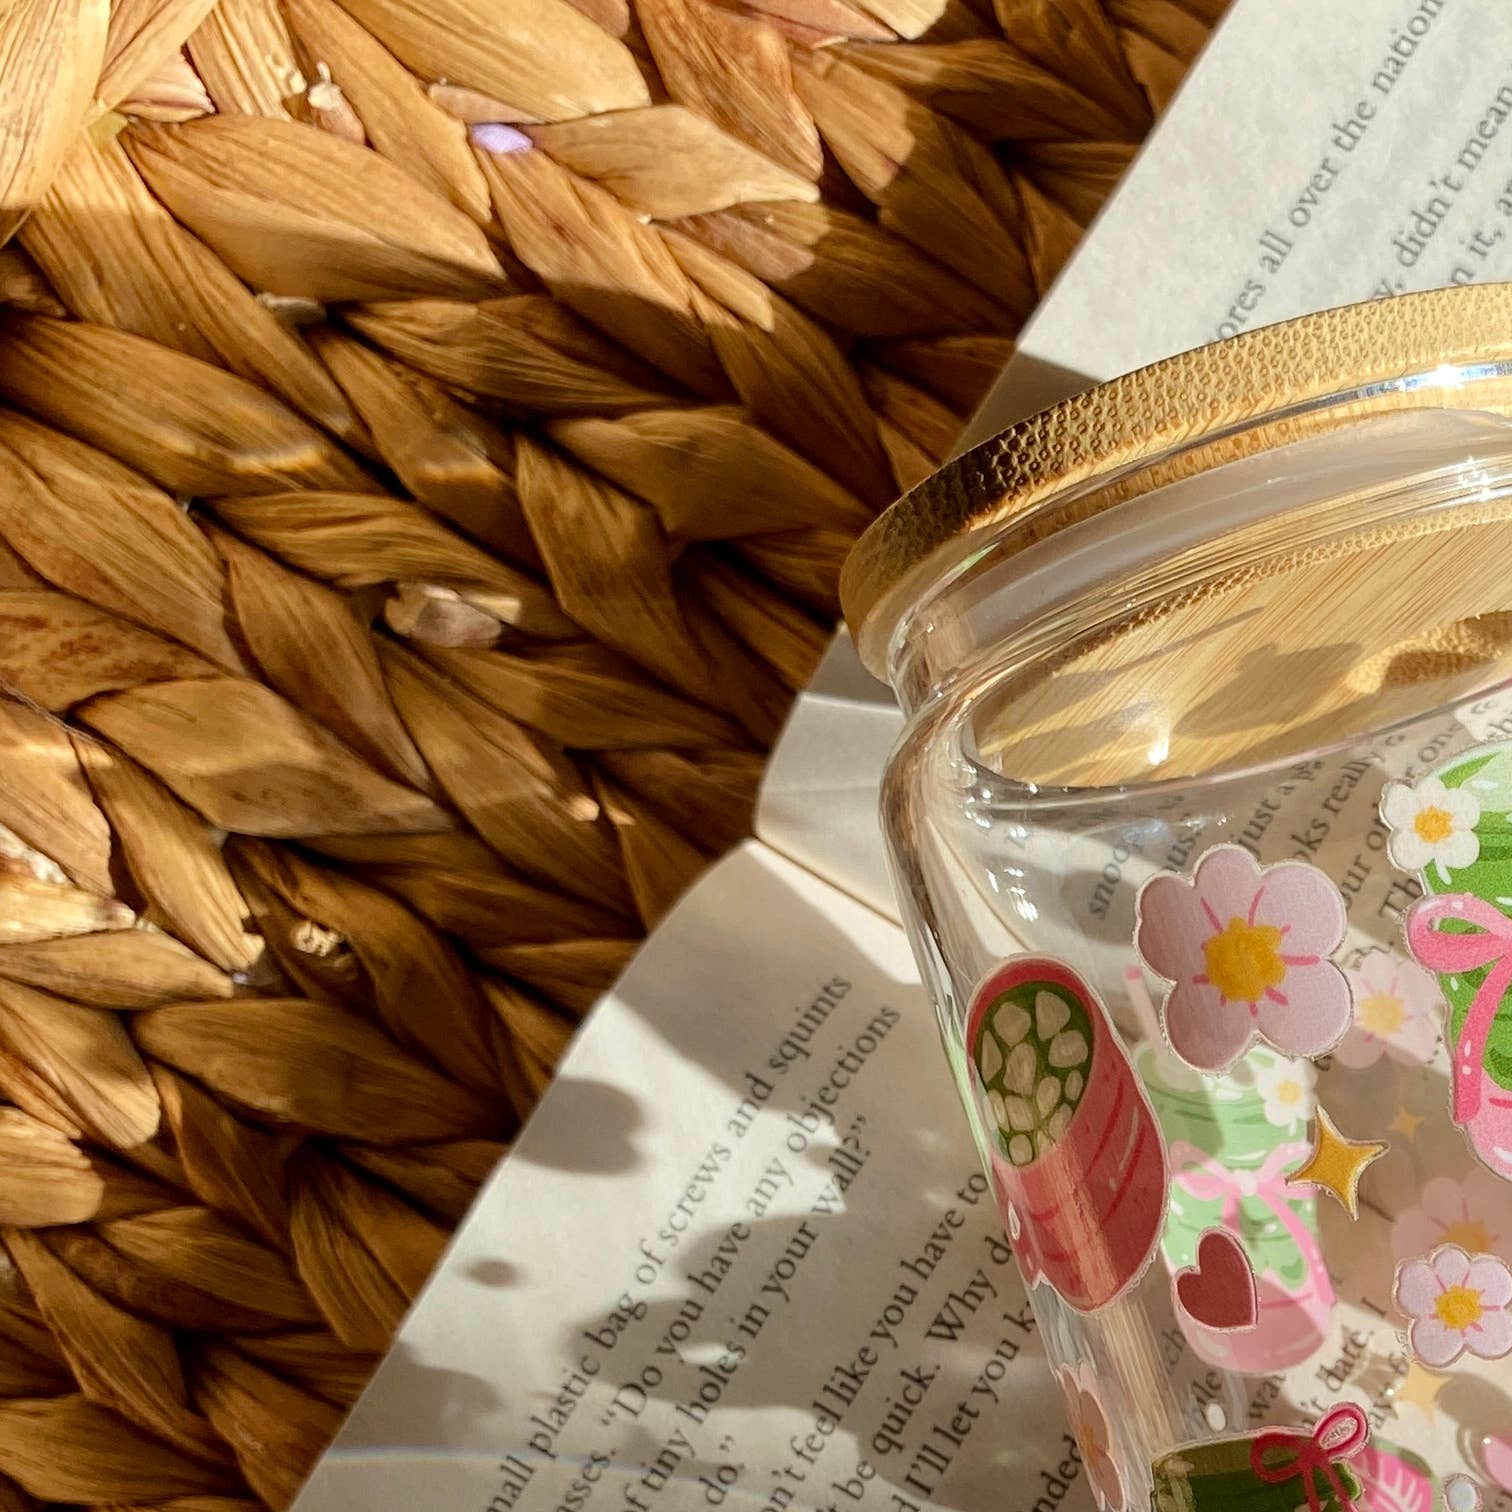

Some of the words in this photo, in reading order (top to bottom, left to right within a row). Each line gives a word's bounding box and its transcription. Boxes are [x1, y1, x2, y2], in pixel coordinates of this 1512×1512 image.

[1257, 229, 1294, 274] all
[1287, 156, 1339, 228] over
[1330, 100, 1376, 152] the
[1391, 174, 1463, 268] didn’t
[1467, 229, 1504, 260] it,
[526, 1354, 600, 1461] plastic
[581, 1291, 646, 1350] bag
[634, 1237, 666, 1285] of
[658, 1143, 731, 1247] screws
[727, 1071, 774, 1138] and
[768, 977, 850, 1068] squints
[654, 1298, 704, 1365] you
[685, 1222, 751, 1294] have
[745, 1157, 794, 1217] any
[785, 1006, 899, 1154] objections
[639, 1427, 695, 1493] tiny
[675, 1340, 746, 1425] holes
[736, 1302, 771, 1339] in
[760, 1220, 818, 1303] your
